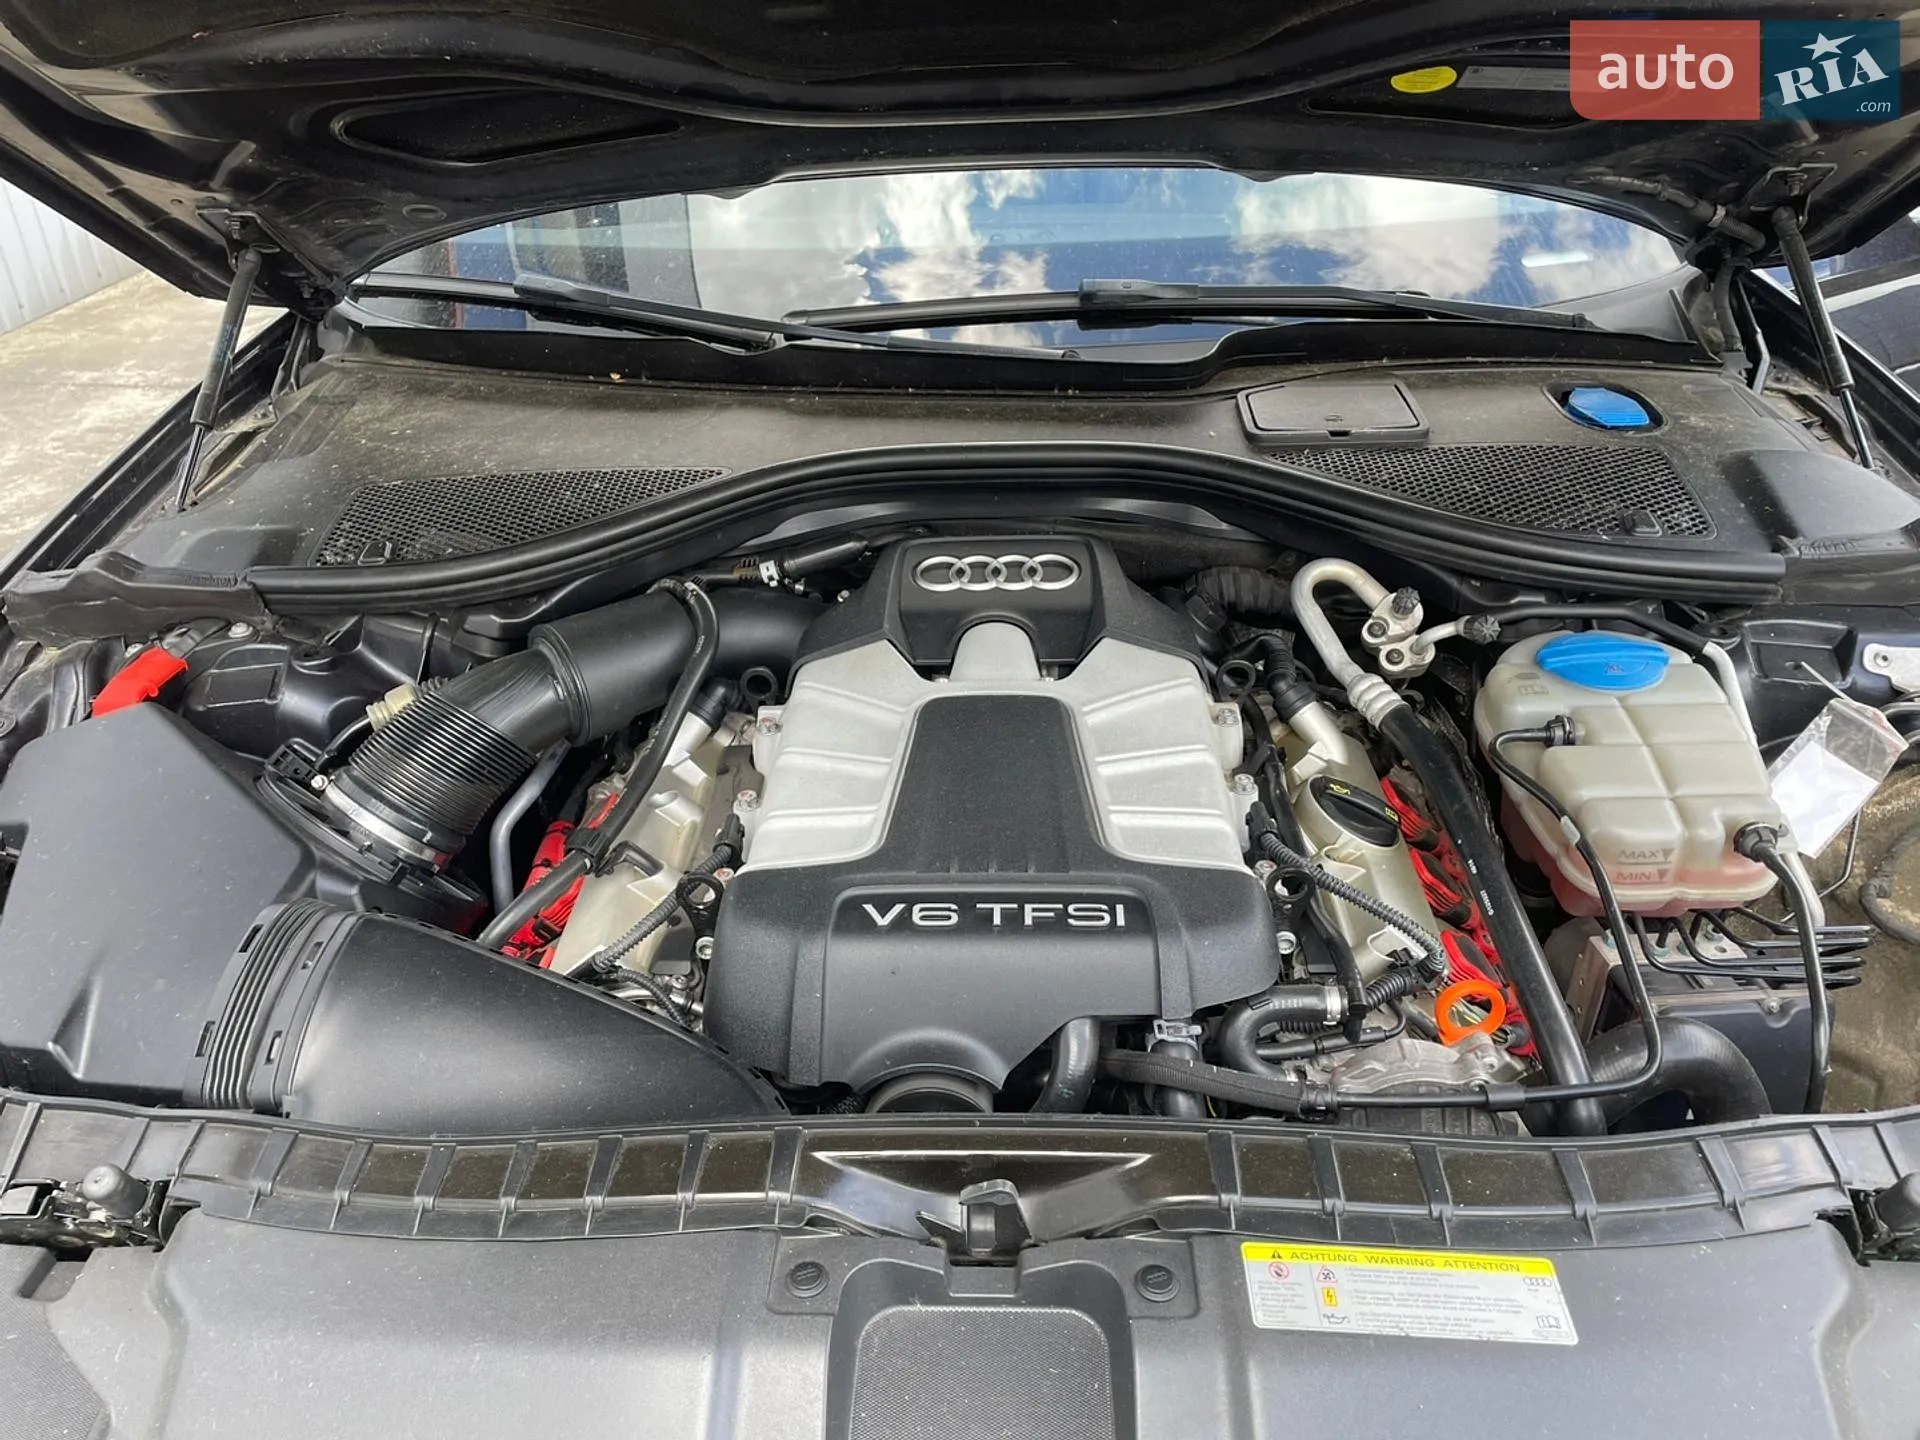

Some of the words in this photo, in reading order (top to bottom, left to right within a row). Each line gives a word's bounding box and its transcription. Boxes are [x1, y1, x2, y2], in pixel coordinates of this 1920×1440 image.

[1619, 849, 1660, 860] MAX
[1615, 871, 1652, 881] MIN
[861, 903, 960, 927] V6
[976, 903, 1126, 927] TFSI
[1290, 1252, 1358, 1263] ACHTUNG
[1364, 1255, 1435, 1268] WARNING
[1443, 1259, 1521, 1272] ATTENTION
